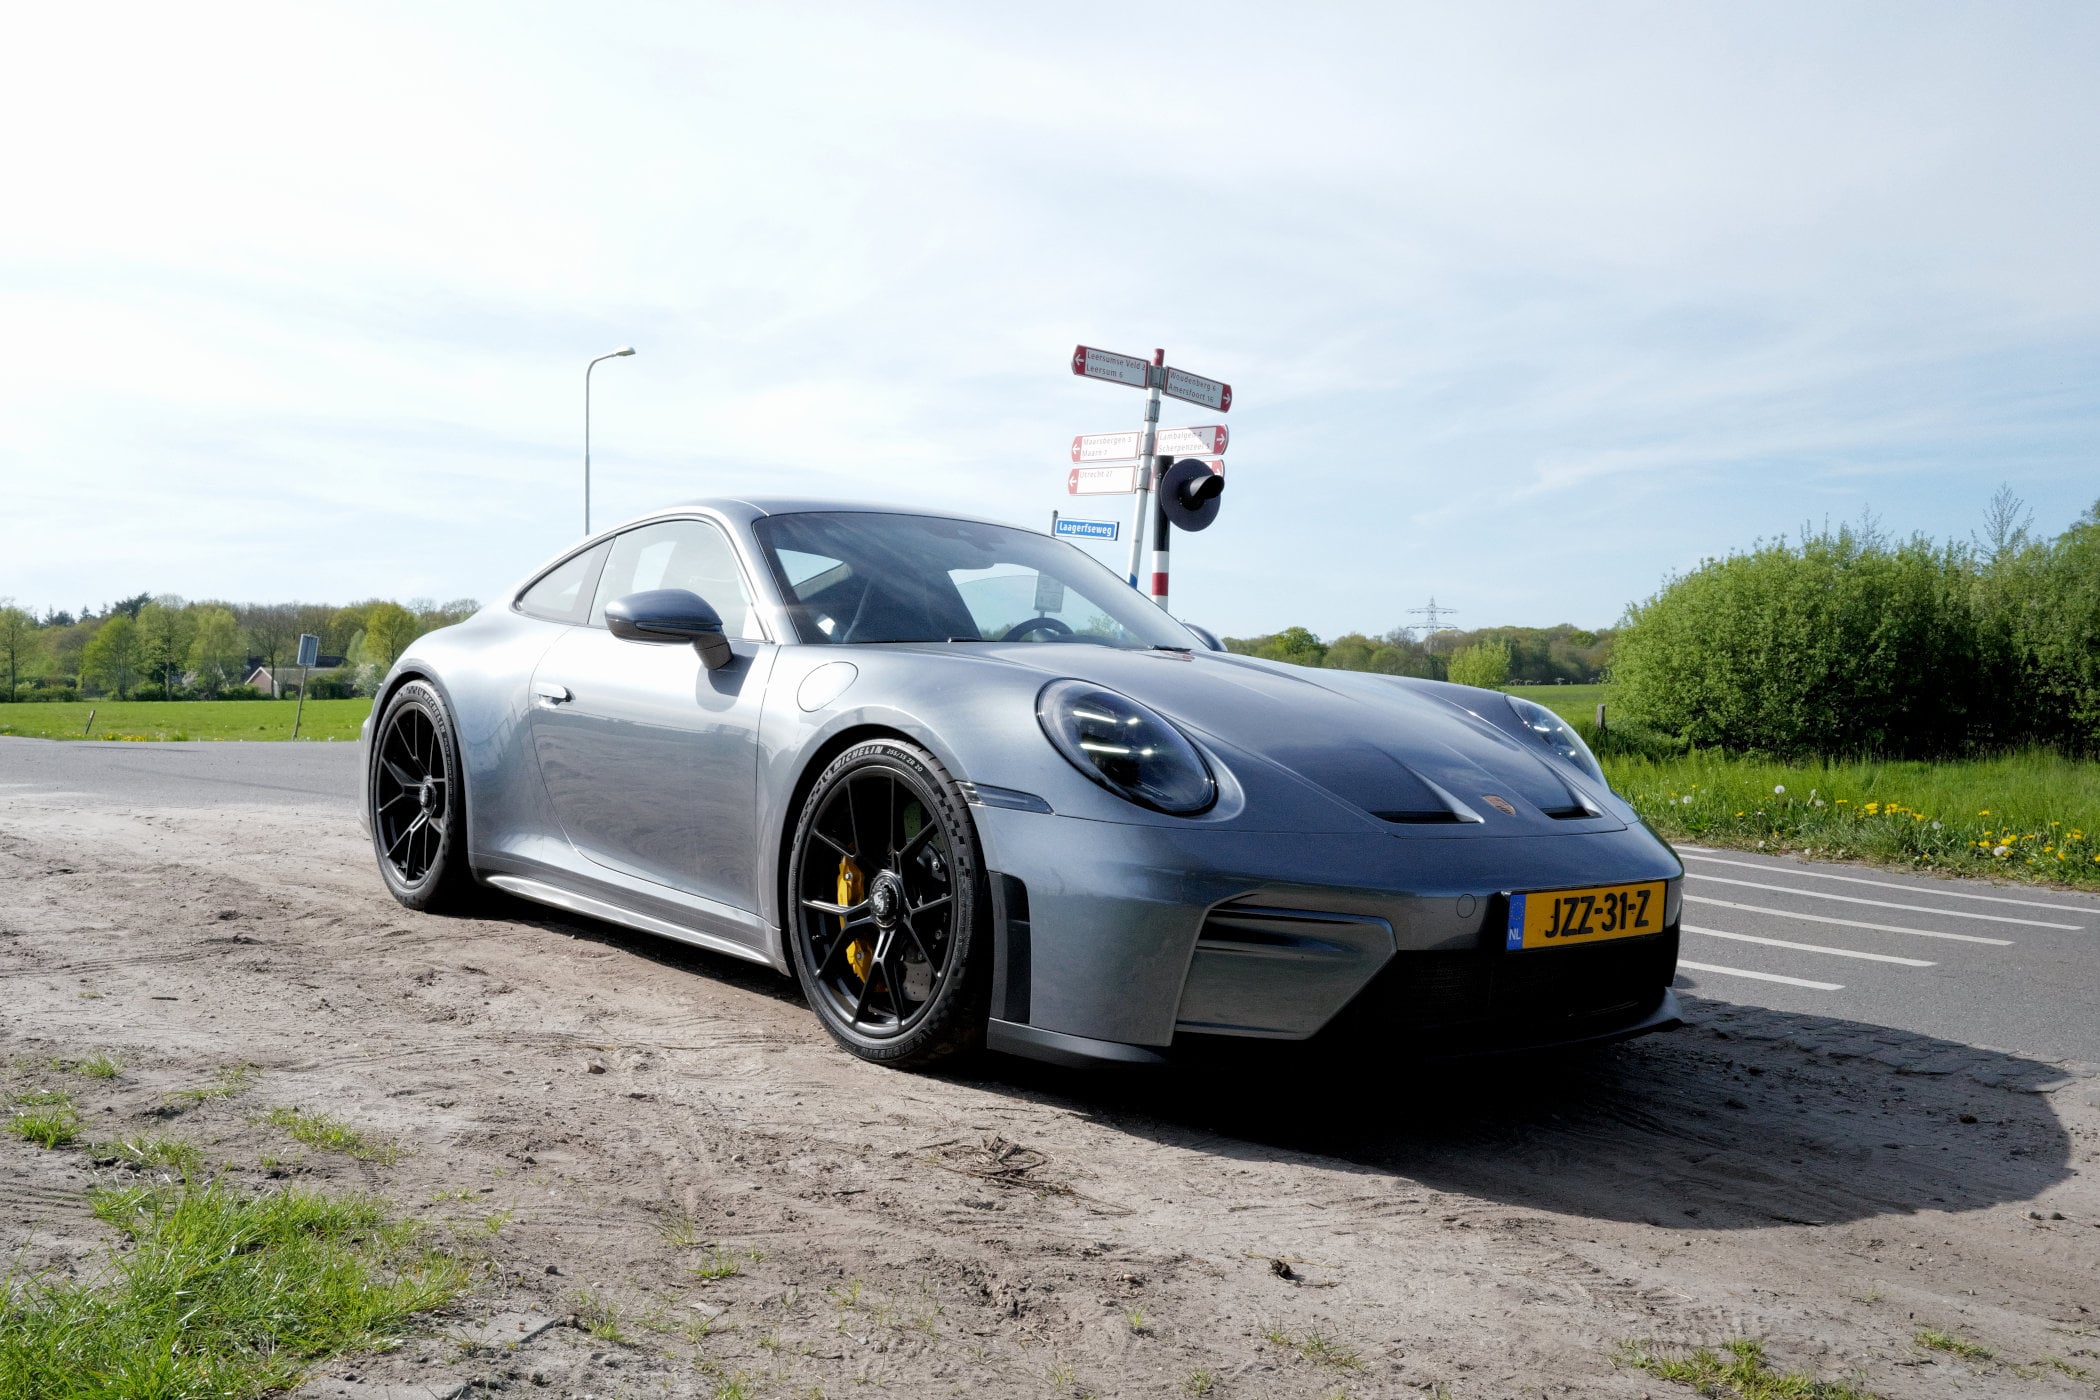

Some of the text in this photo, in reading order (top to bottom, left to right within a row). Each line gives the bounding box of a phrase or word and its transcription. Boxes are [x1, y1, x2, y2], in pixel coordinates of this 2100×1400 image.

[1087, 351, 1124, 366] Leersumse
[1125, 359, 1140, 370] Veld
[1086, 364, 1117, 377] Leersum
[1170, 371, 1211, 392] Woudenberg
[1168, 383, 1206, 401] Amersfoort
[1083, 436, 1126, 445] Maarsbergen
[1079, 470, 1104, 479] Utrecht
[1059, 521, 1112, 537] Laagerfseweg
[424, 692, 446, 733] MICHELIN
[833, 745, 884, 771] MICHELIN
[914, 764, 923, 772] 20
[1544, 889, 1652, 938] JZZ-31-Z
[1508, 928, 1522, 941] NL
